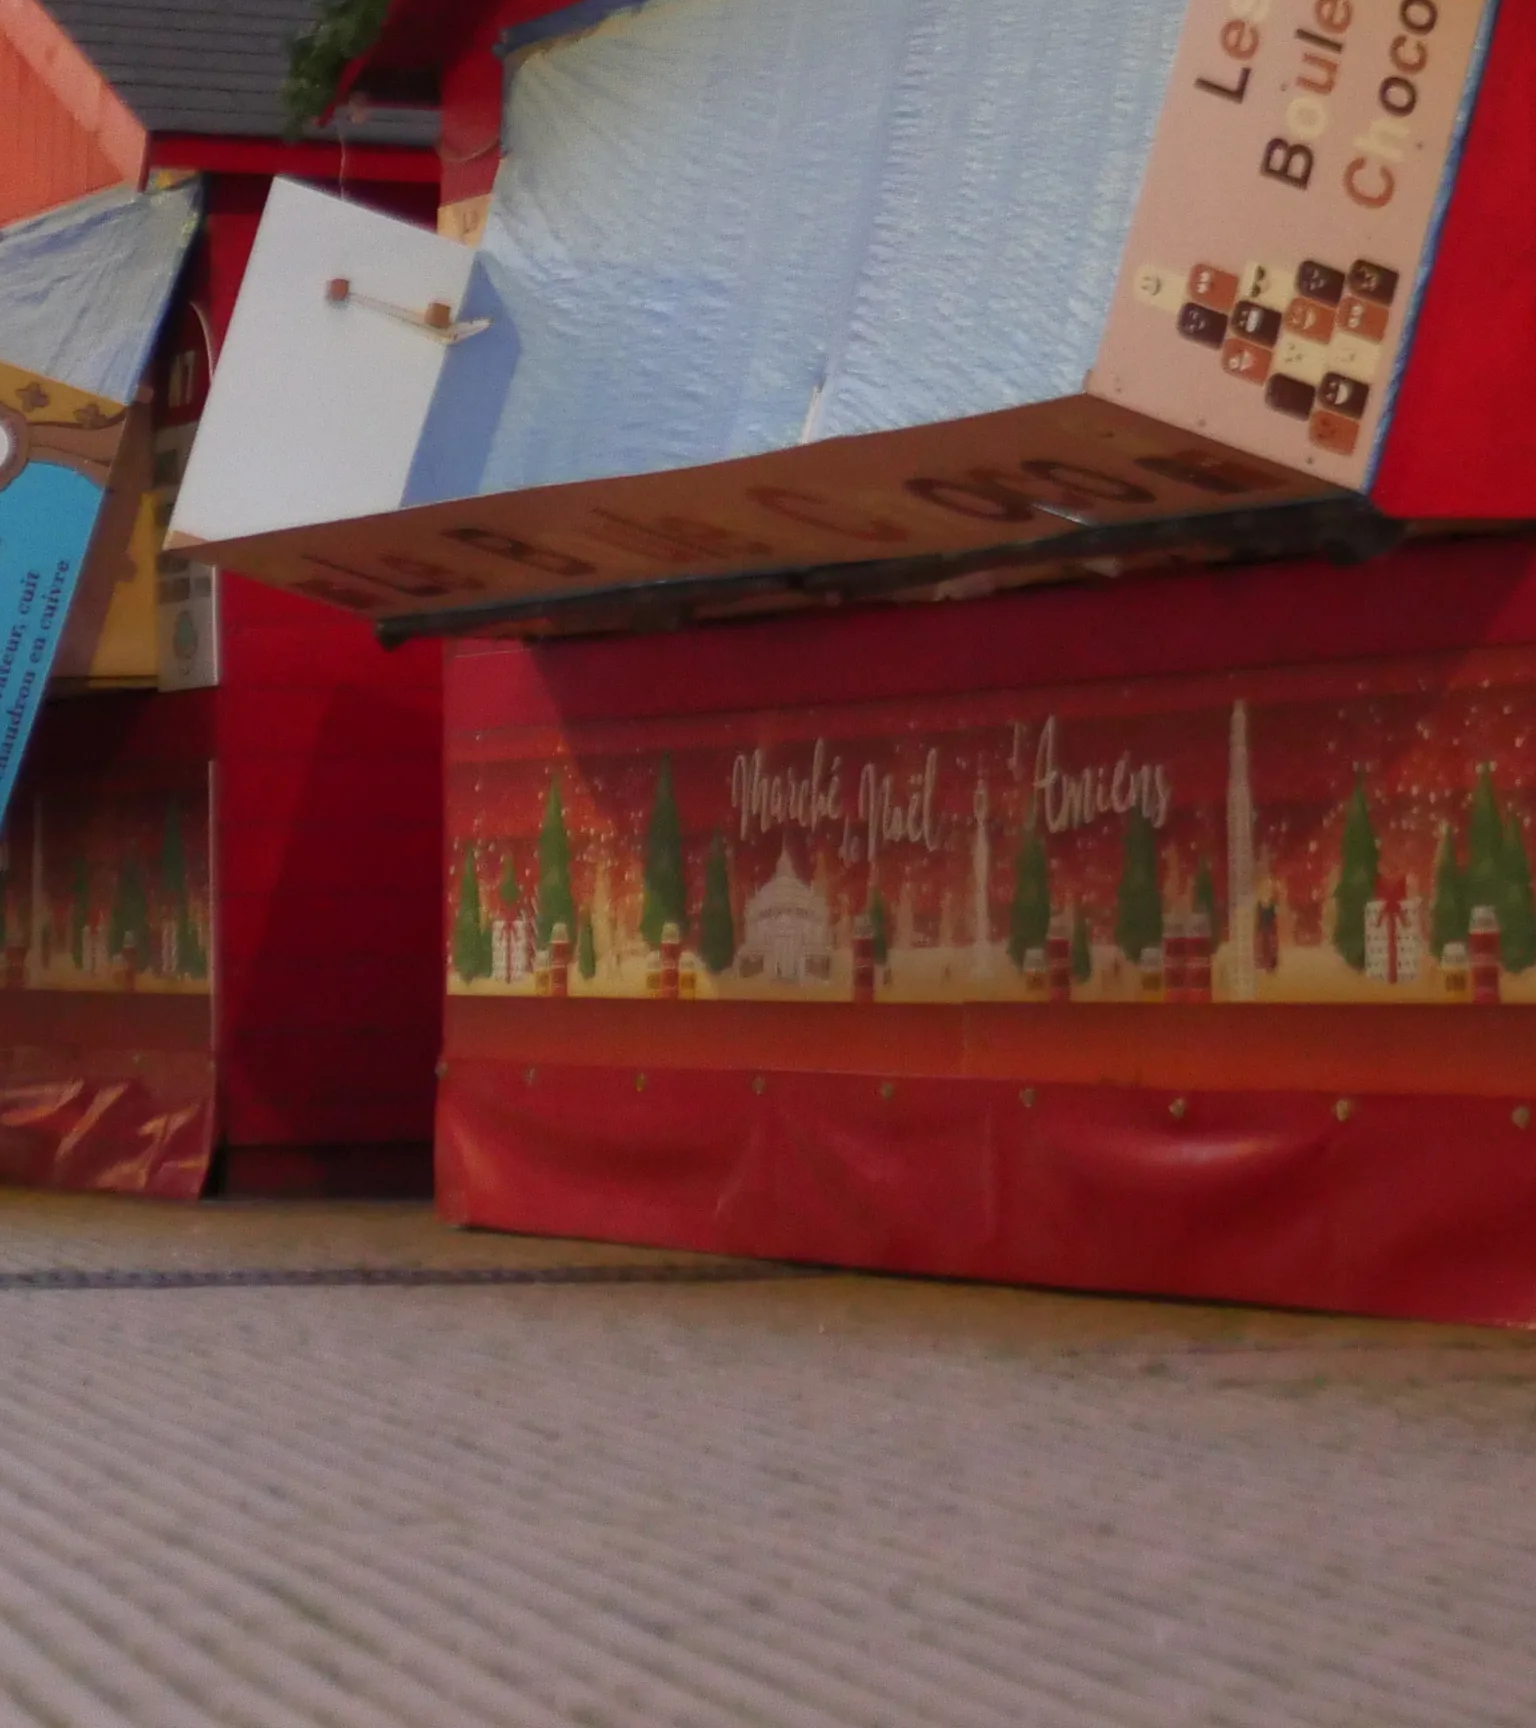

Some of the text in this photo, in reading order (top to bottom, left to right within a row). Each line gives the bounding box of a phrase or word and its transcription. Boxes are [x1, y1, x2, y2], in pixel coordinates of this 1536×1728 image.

[19, 569, 41, 615] cuit
[29, 636, 46, 663] en
[40, 559, 71, 631] cuivre
[732, 737, 843, 841] Marché
[858, 747, 941, 863] Noël
